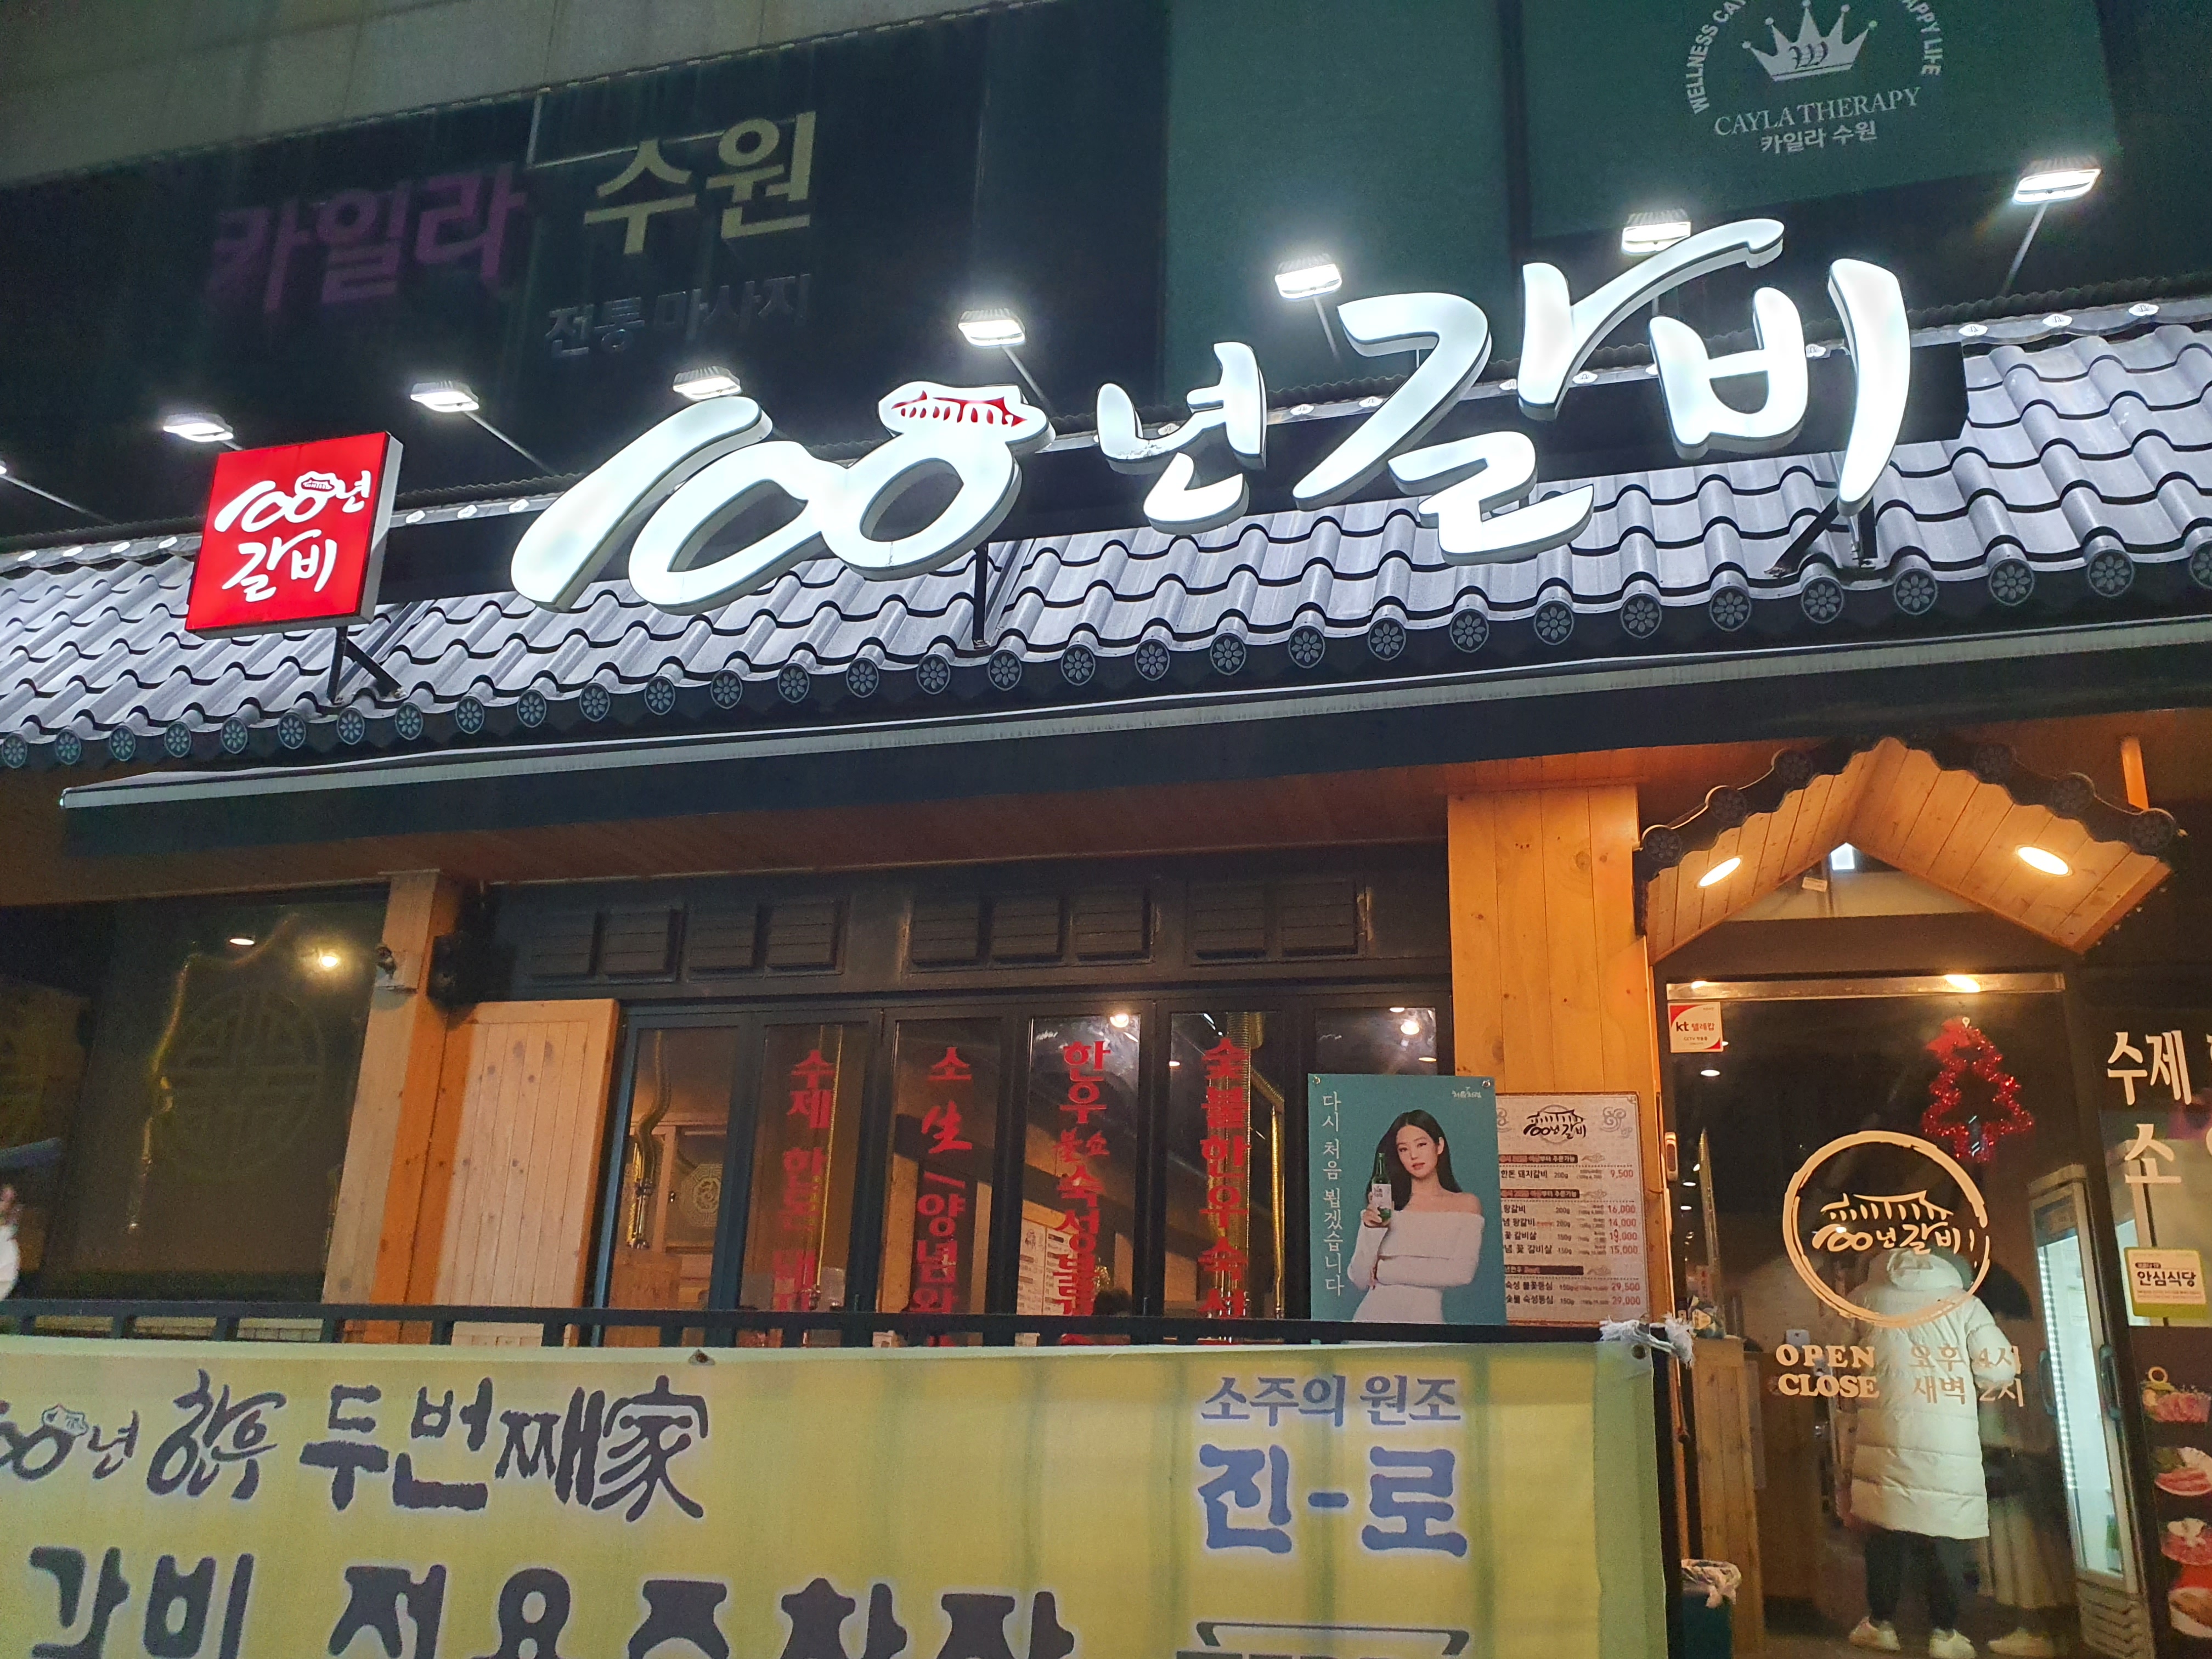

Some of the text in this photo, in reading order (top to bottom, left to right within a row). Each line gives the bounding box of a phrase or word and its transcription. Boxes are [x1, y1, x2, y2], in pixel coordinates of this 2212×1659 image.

[1686, 0, 1746, 114] WELLNESS CA
[1921, 38, 1944, 77] LIFE
[1714, 87, 1921, 136] CAYLA THERAPY
[1760, 120, 1877, 154] 카일라 수원
[584, 110, 816, 256] 수원
[545, 273, 812, 358] 전통 마사지
[214, 470, 371, 532] 100년
[222, 529, 337, 602] 갈비
[1676, 1021, 1689, 1032] kt
[927, 1047, 972, 1081] 소
[2107, 1030, 2192, 1105] 수제
[787, 1049, 836, 1129] 수제
[2124, 1124, 2182, 1184] 소
[1610, 1169, 1634, 1178] 9,500
[1322, 1091, 1345, 1297] 다시 처음 뵙겠습니다
[1607, 1205, 1636, 1214] 16,000
[1609, 1218, 1637, 1227] 14,000
[1610, 1245, 1638, 1254] 15,000
[1611, 1282, 1640, 1291] 29,500
[2137, 1271, 2197, 1288] 안심식당
[1612, 1296, 1641, 1305] 29,000
[1775, 1344, 1876, 1368] OPEN
[1910, 1344, 1965, 1372] 오후
[1201, 1373, 1463, 1427] 소주의 원조
[1778, 1374, 1880, 1398] CLOSE
[1913, 1376, 1966, 1405] 새벽
